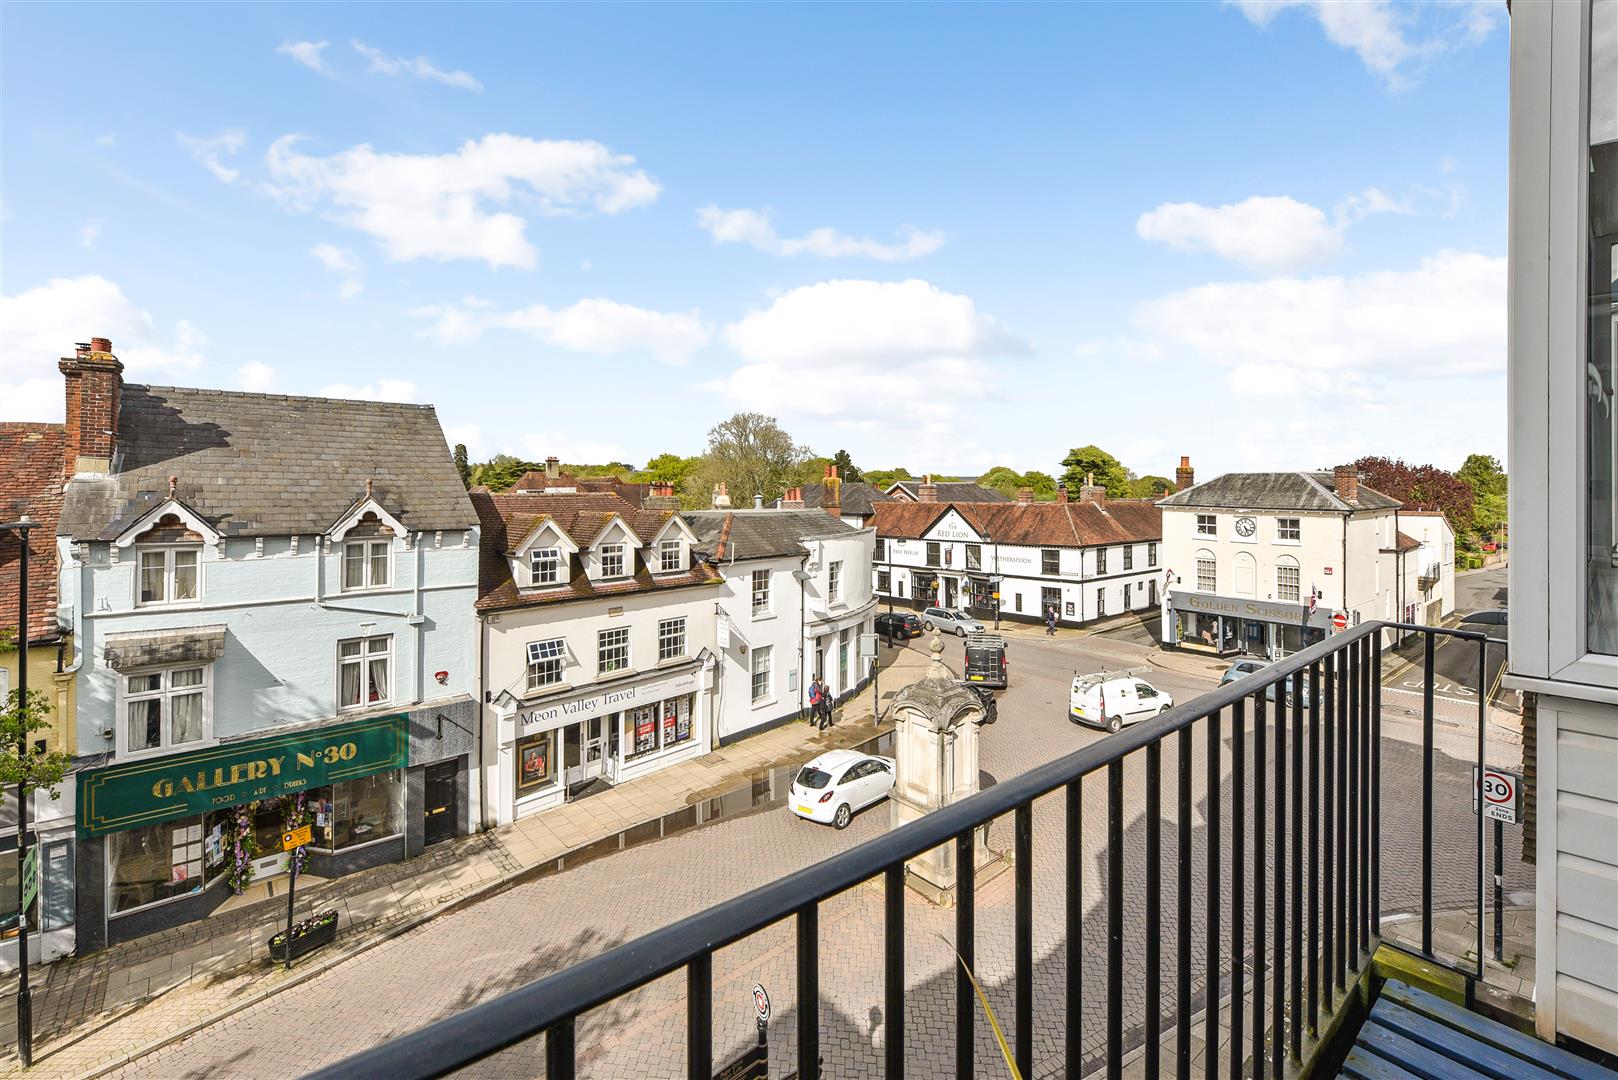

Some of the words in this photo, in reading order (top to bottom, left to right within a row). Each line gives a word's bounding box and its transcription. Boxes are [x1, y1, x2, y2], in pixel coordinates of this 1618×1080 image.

[937, 530, 951, 538] RED
[952, 530, 969, 538] LION
[1189, 596, 1239, 612] GOLDEN
[520, 709, 558, 727] Meon
[562, 699, 598, 715] Valley
[602, 686, 636, 705] Travel
[151, 755, 286, 799] GALLERY
[1484, 780, 1507, 796] 30
[1491, 810, 1513, 821] ENDS
